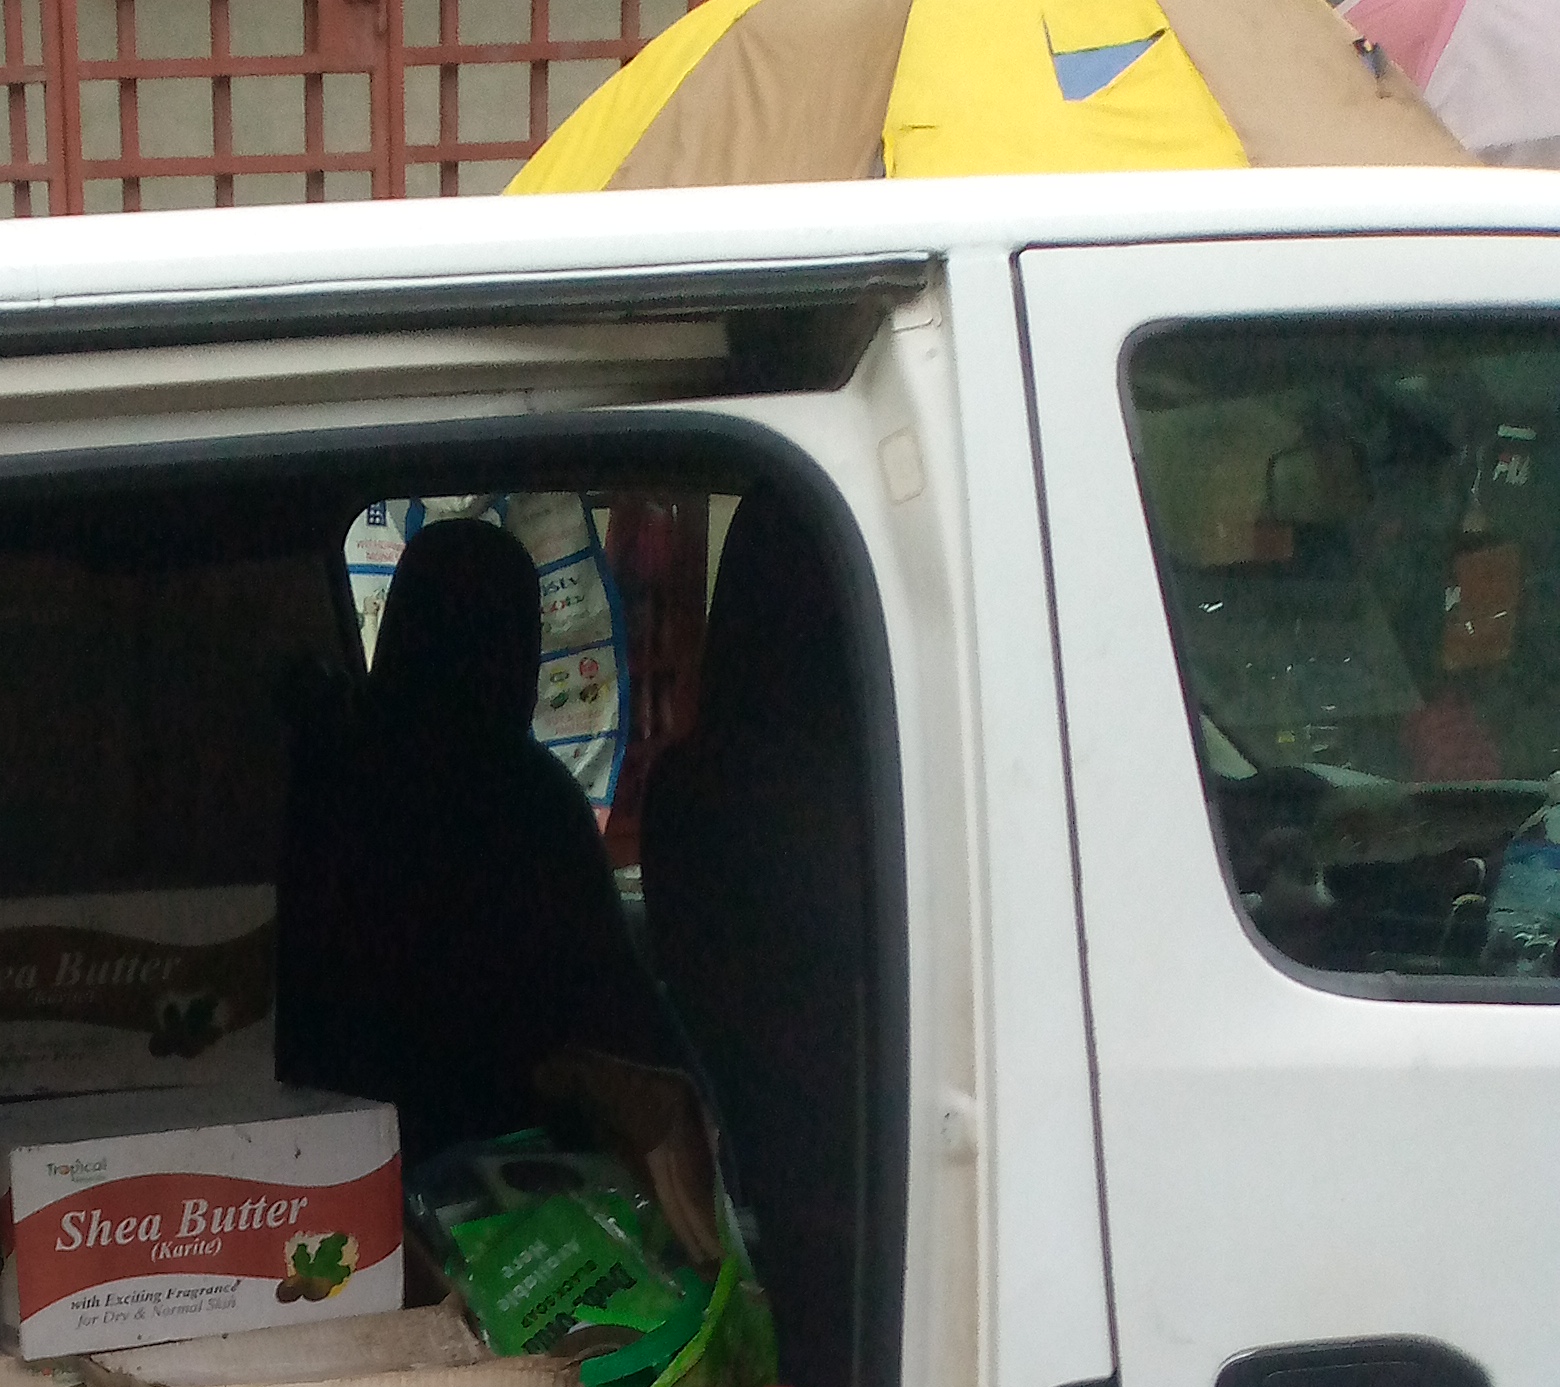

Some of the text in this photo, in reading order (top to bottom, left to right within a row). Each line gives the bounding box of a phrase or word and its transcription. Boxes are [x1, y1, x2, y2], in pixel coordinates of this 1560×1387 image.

[55, 951, 182, 986] Butter
[55, 1195, 308, 1253] Shea Butter
[71, 1280, 241, 1311] with Exciting Fragrance
[103, 1310, 130, 1329] Dry
[151, 1300, 204, 1320] Normal
